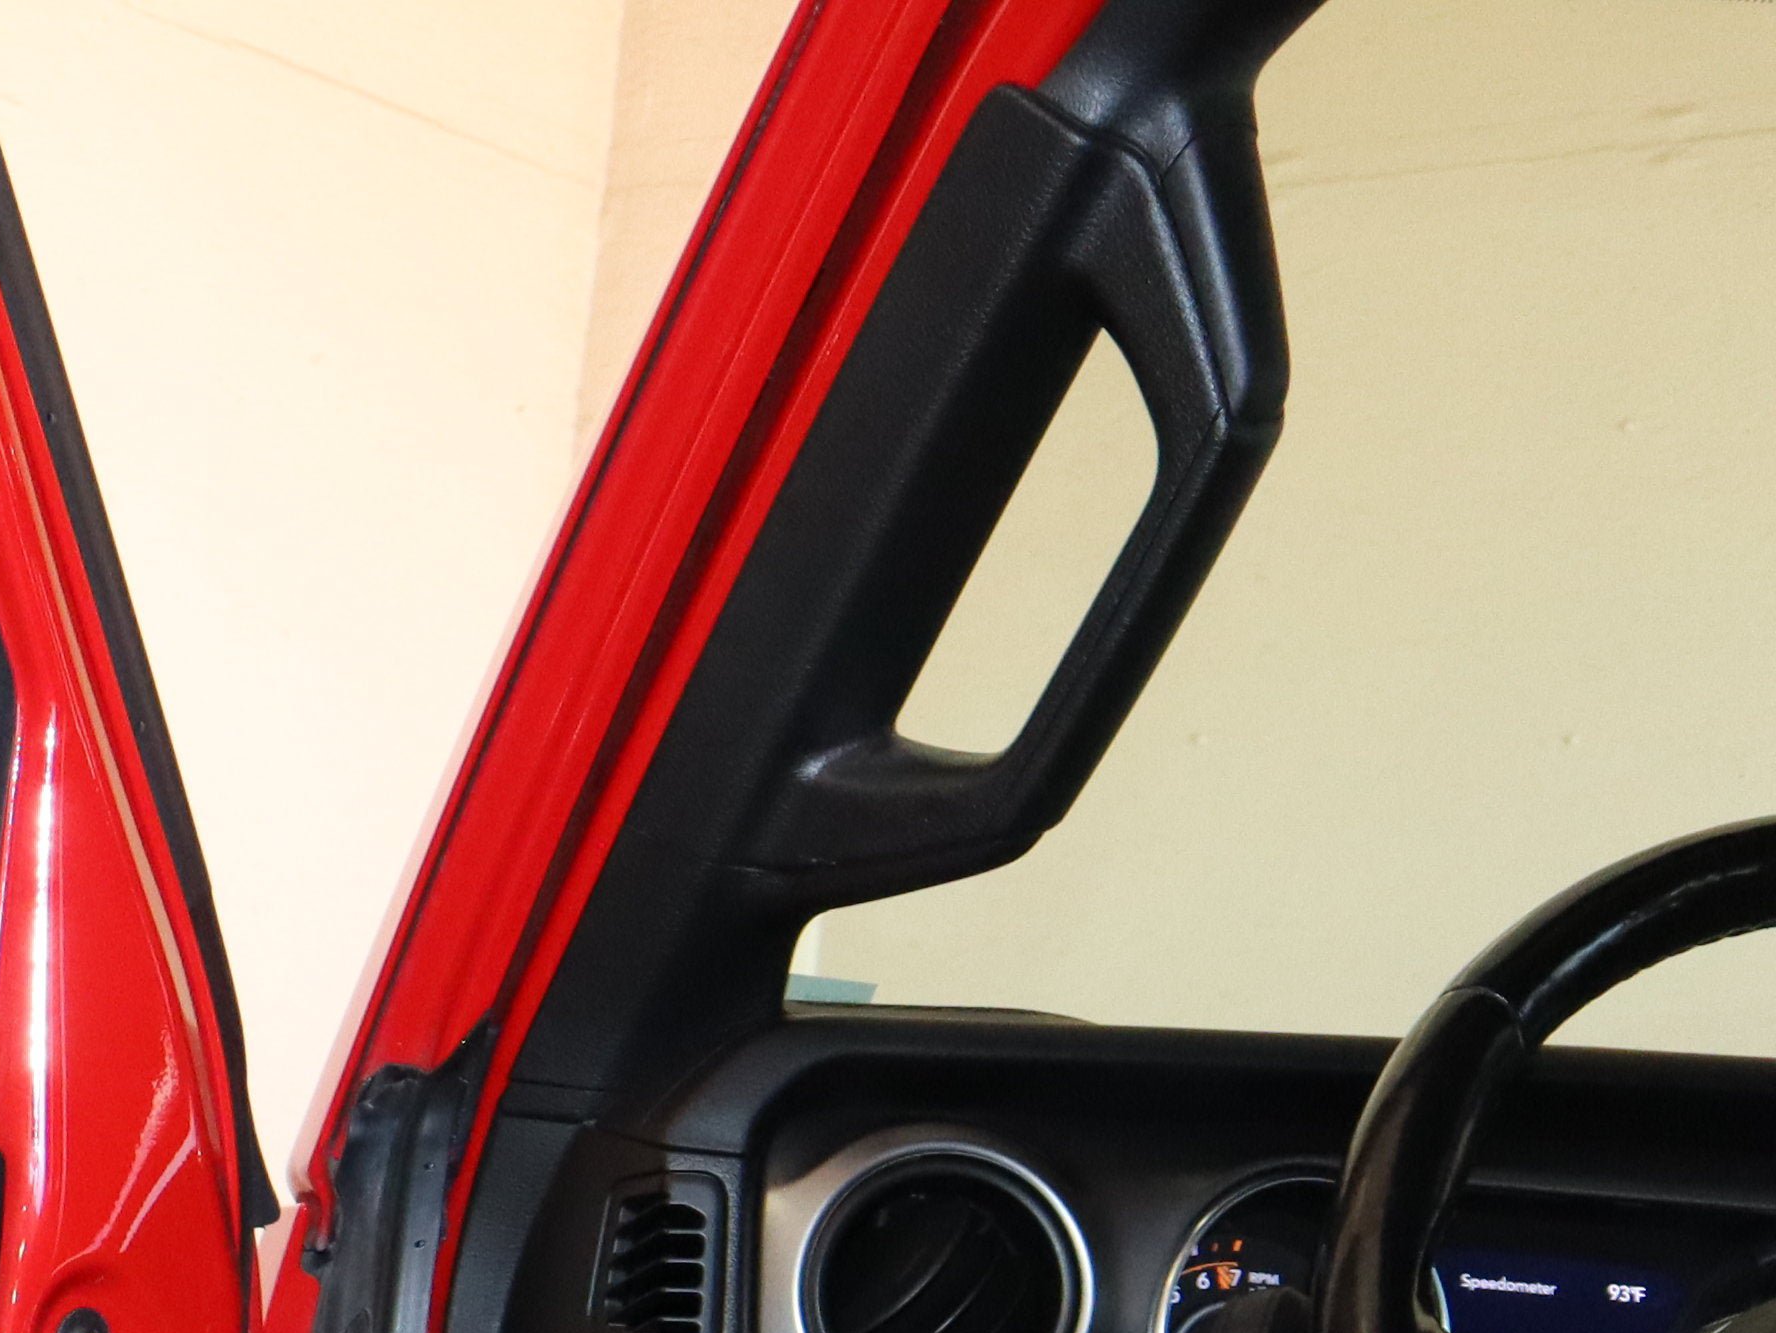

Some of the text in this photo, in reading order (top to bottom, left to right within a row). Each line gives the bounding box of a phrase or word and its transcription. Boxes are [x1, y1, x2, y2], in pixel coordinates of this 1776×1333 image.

[1195, 1271, 1211, 1290] 6
[1229, 1268, 1243, 1287] 7
[1248, 1271, 1281, 1286] RPM
[1459, 1272, 1558, 1297] Speedometer
